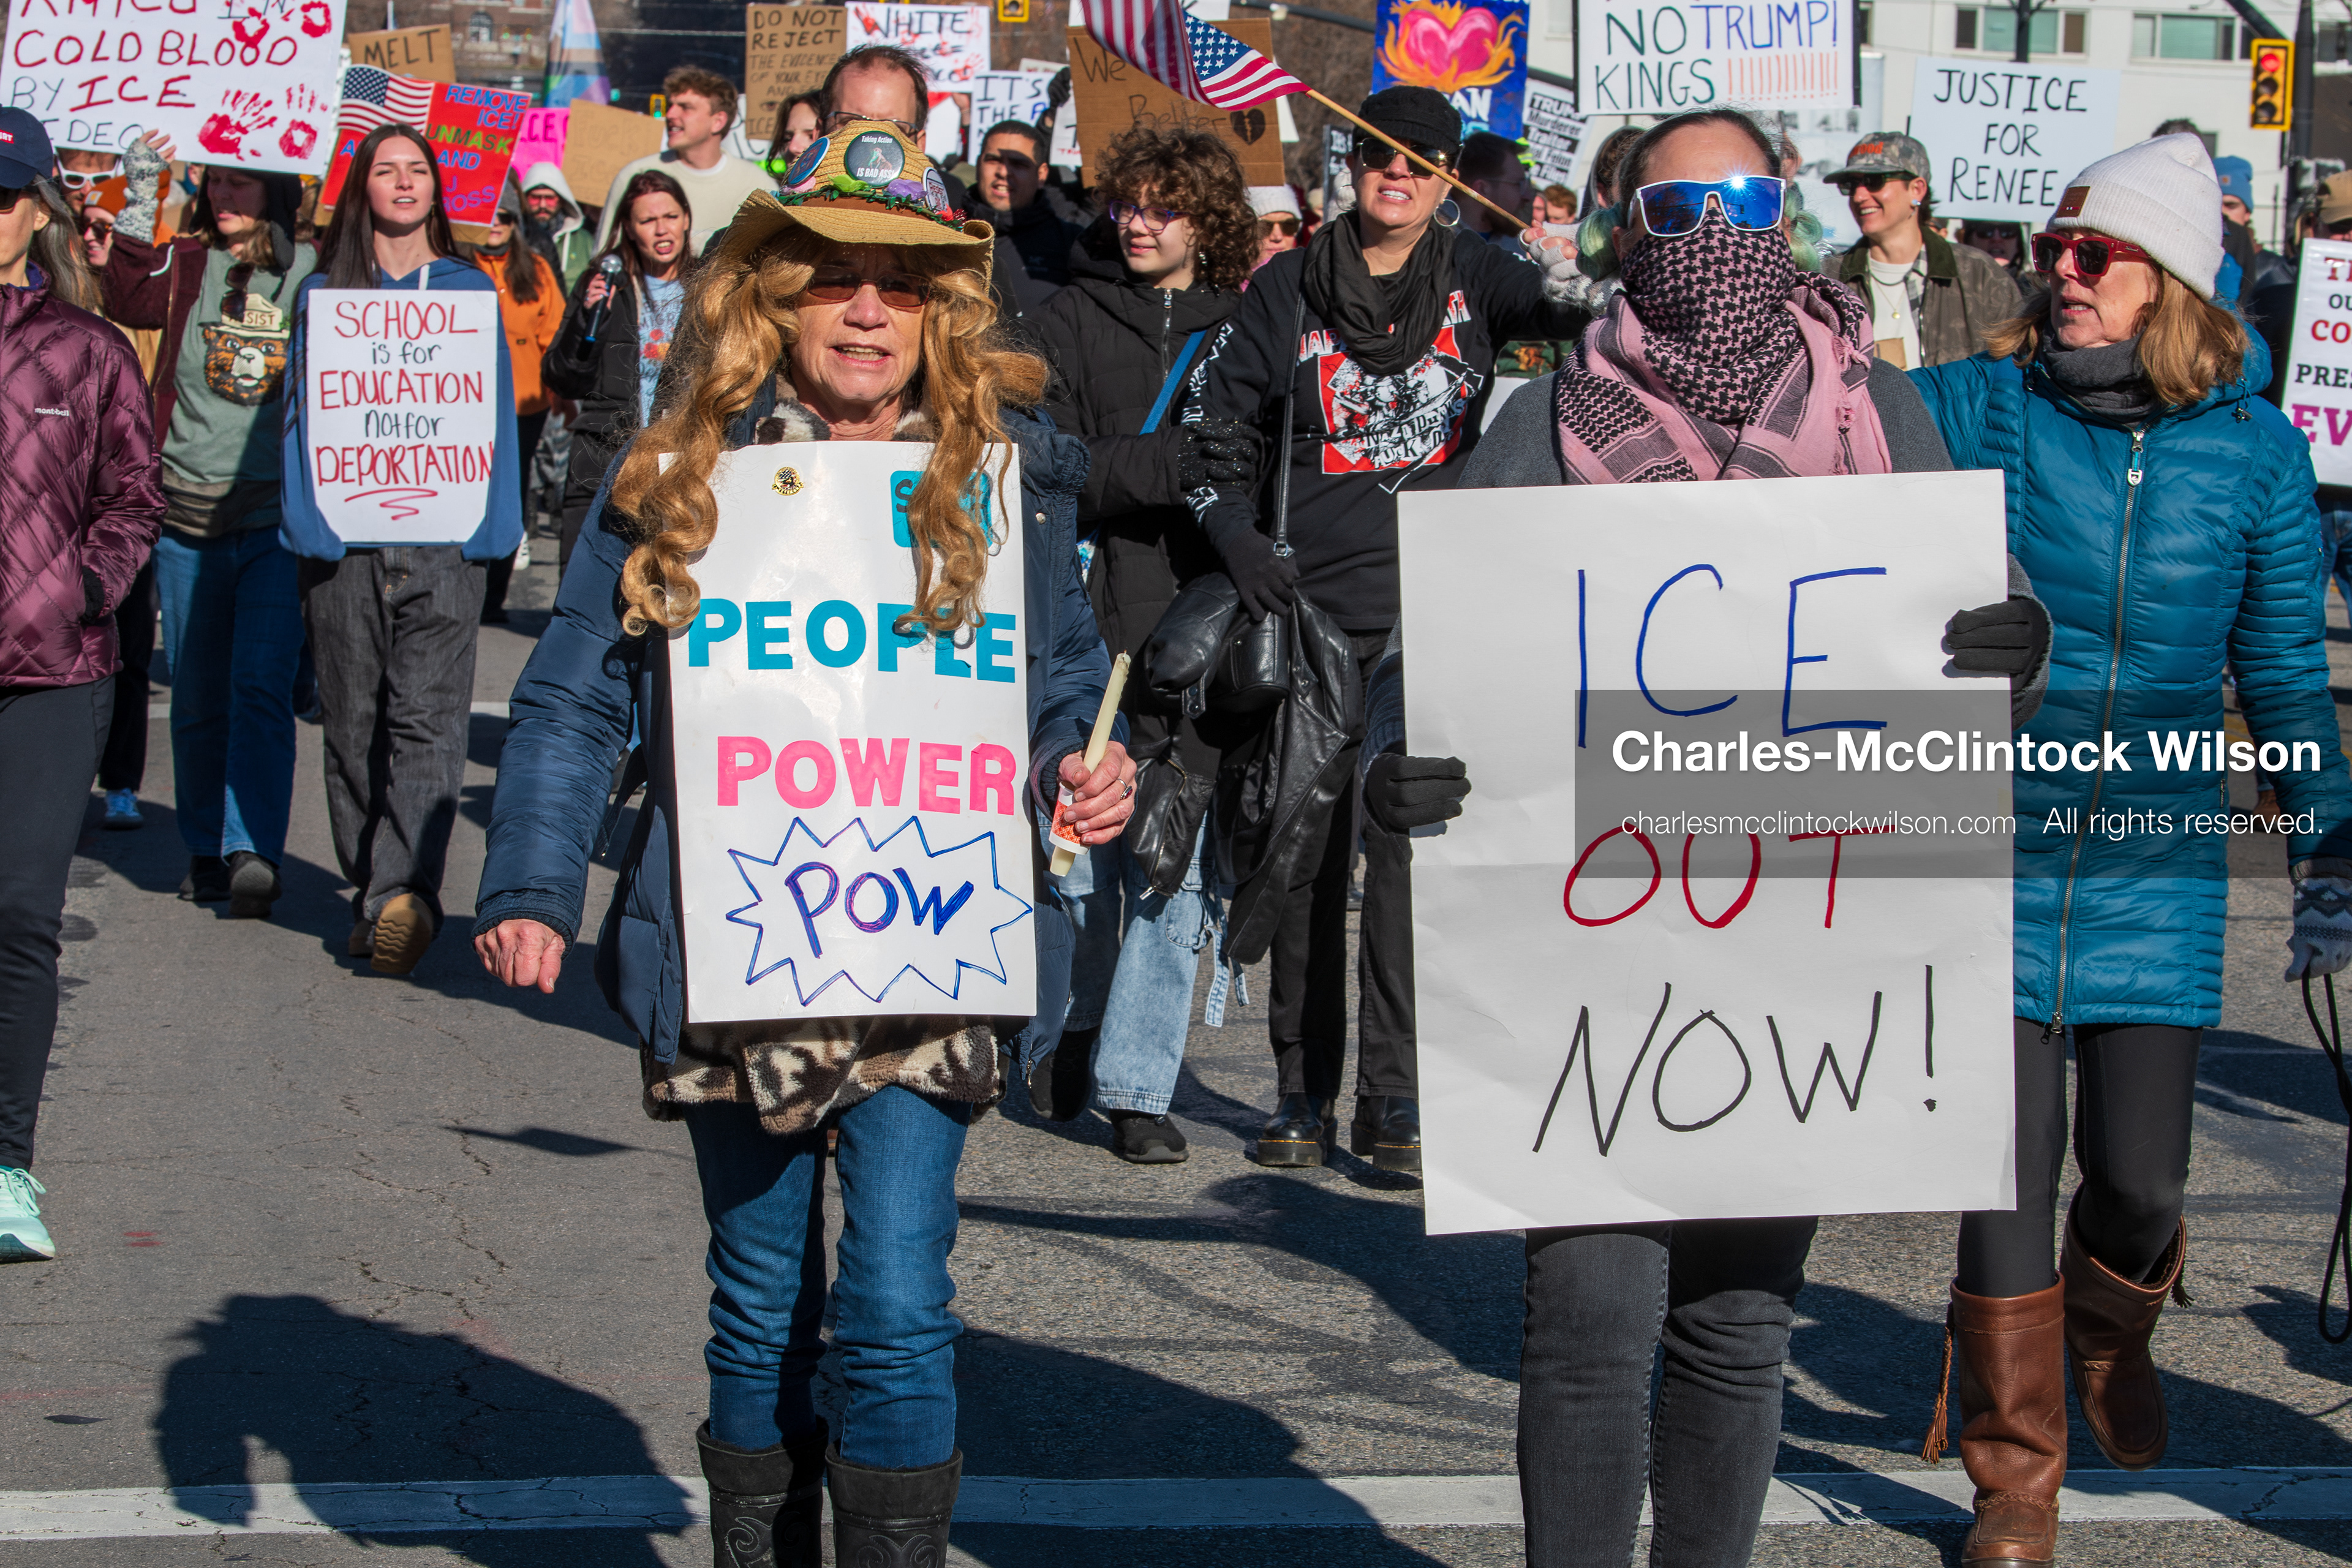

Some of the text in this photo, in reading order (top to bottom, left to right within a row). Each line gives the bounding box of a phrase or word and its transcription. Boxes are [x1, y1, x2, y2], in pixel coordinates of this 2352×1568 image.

[754, 9, 843, 29] DO NOT
[854, 7, 970, 37] WHITE
[1605, 0, 1838, 56] NO TRUMP!
[14, 29, 297, 67] COLD BLOOD
[364, 28, 441, 70] MELT
[752, 29, 841, 50] REJECT
[749, 53, 775, 70] THE
[10, 74, 195, 112] BY ICE
[445, 85, 529, 113] REMOVE
[975, 75, 1043, 103] IT'S
[1595, 58, 1715, 110] KINGS
[1934, 69, 2087, 113] JUSTICE
[477, 108, 521, 130] ICE!
[519, 113, 556, 141] CE
[977, 104, 1020, 124] THE
[426, 124, 513, 155] UNMASK
[861, 135, 877, 144] Taking
[1983, 124, 2042, 157] FOR
[437, 149, 481, 170] AND
[856, 167, 864, 177] IS
[864, 168, 878, 178] BAD
[445, 175, 458, 192] J
[1949, 157, 2059, 207] RENEE
[334, 300, 478, 340] SCHOOL
[371, 341, 442, 364] is for
[319, 368, 484, 410] EDUCATION
[315, 441, 494, 487] DEPORTATION
[688, 598, 1016, 684] PEOPLE
[1578, 564, 1887, 748] ICE
[717, 736, 1017, 816] POWER
[1564, 821, 1896, 929] OUT
[785, 861, 974, 959] POW
[1532, 964, 1937, 1157] NOW!
